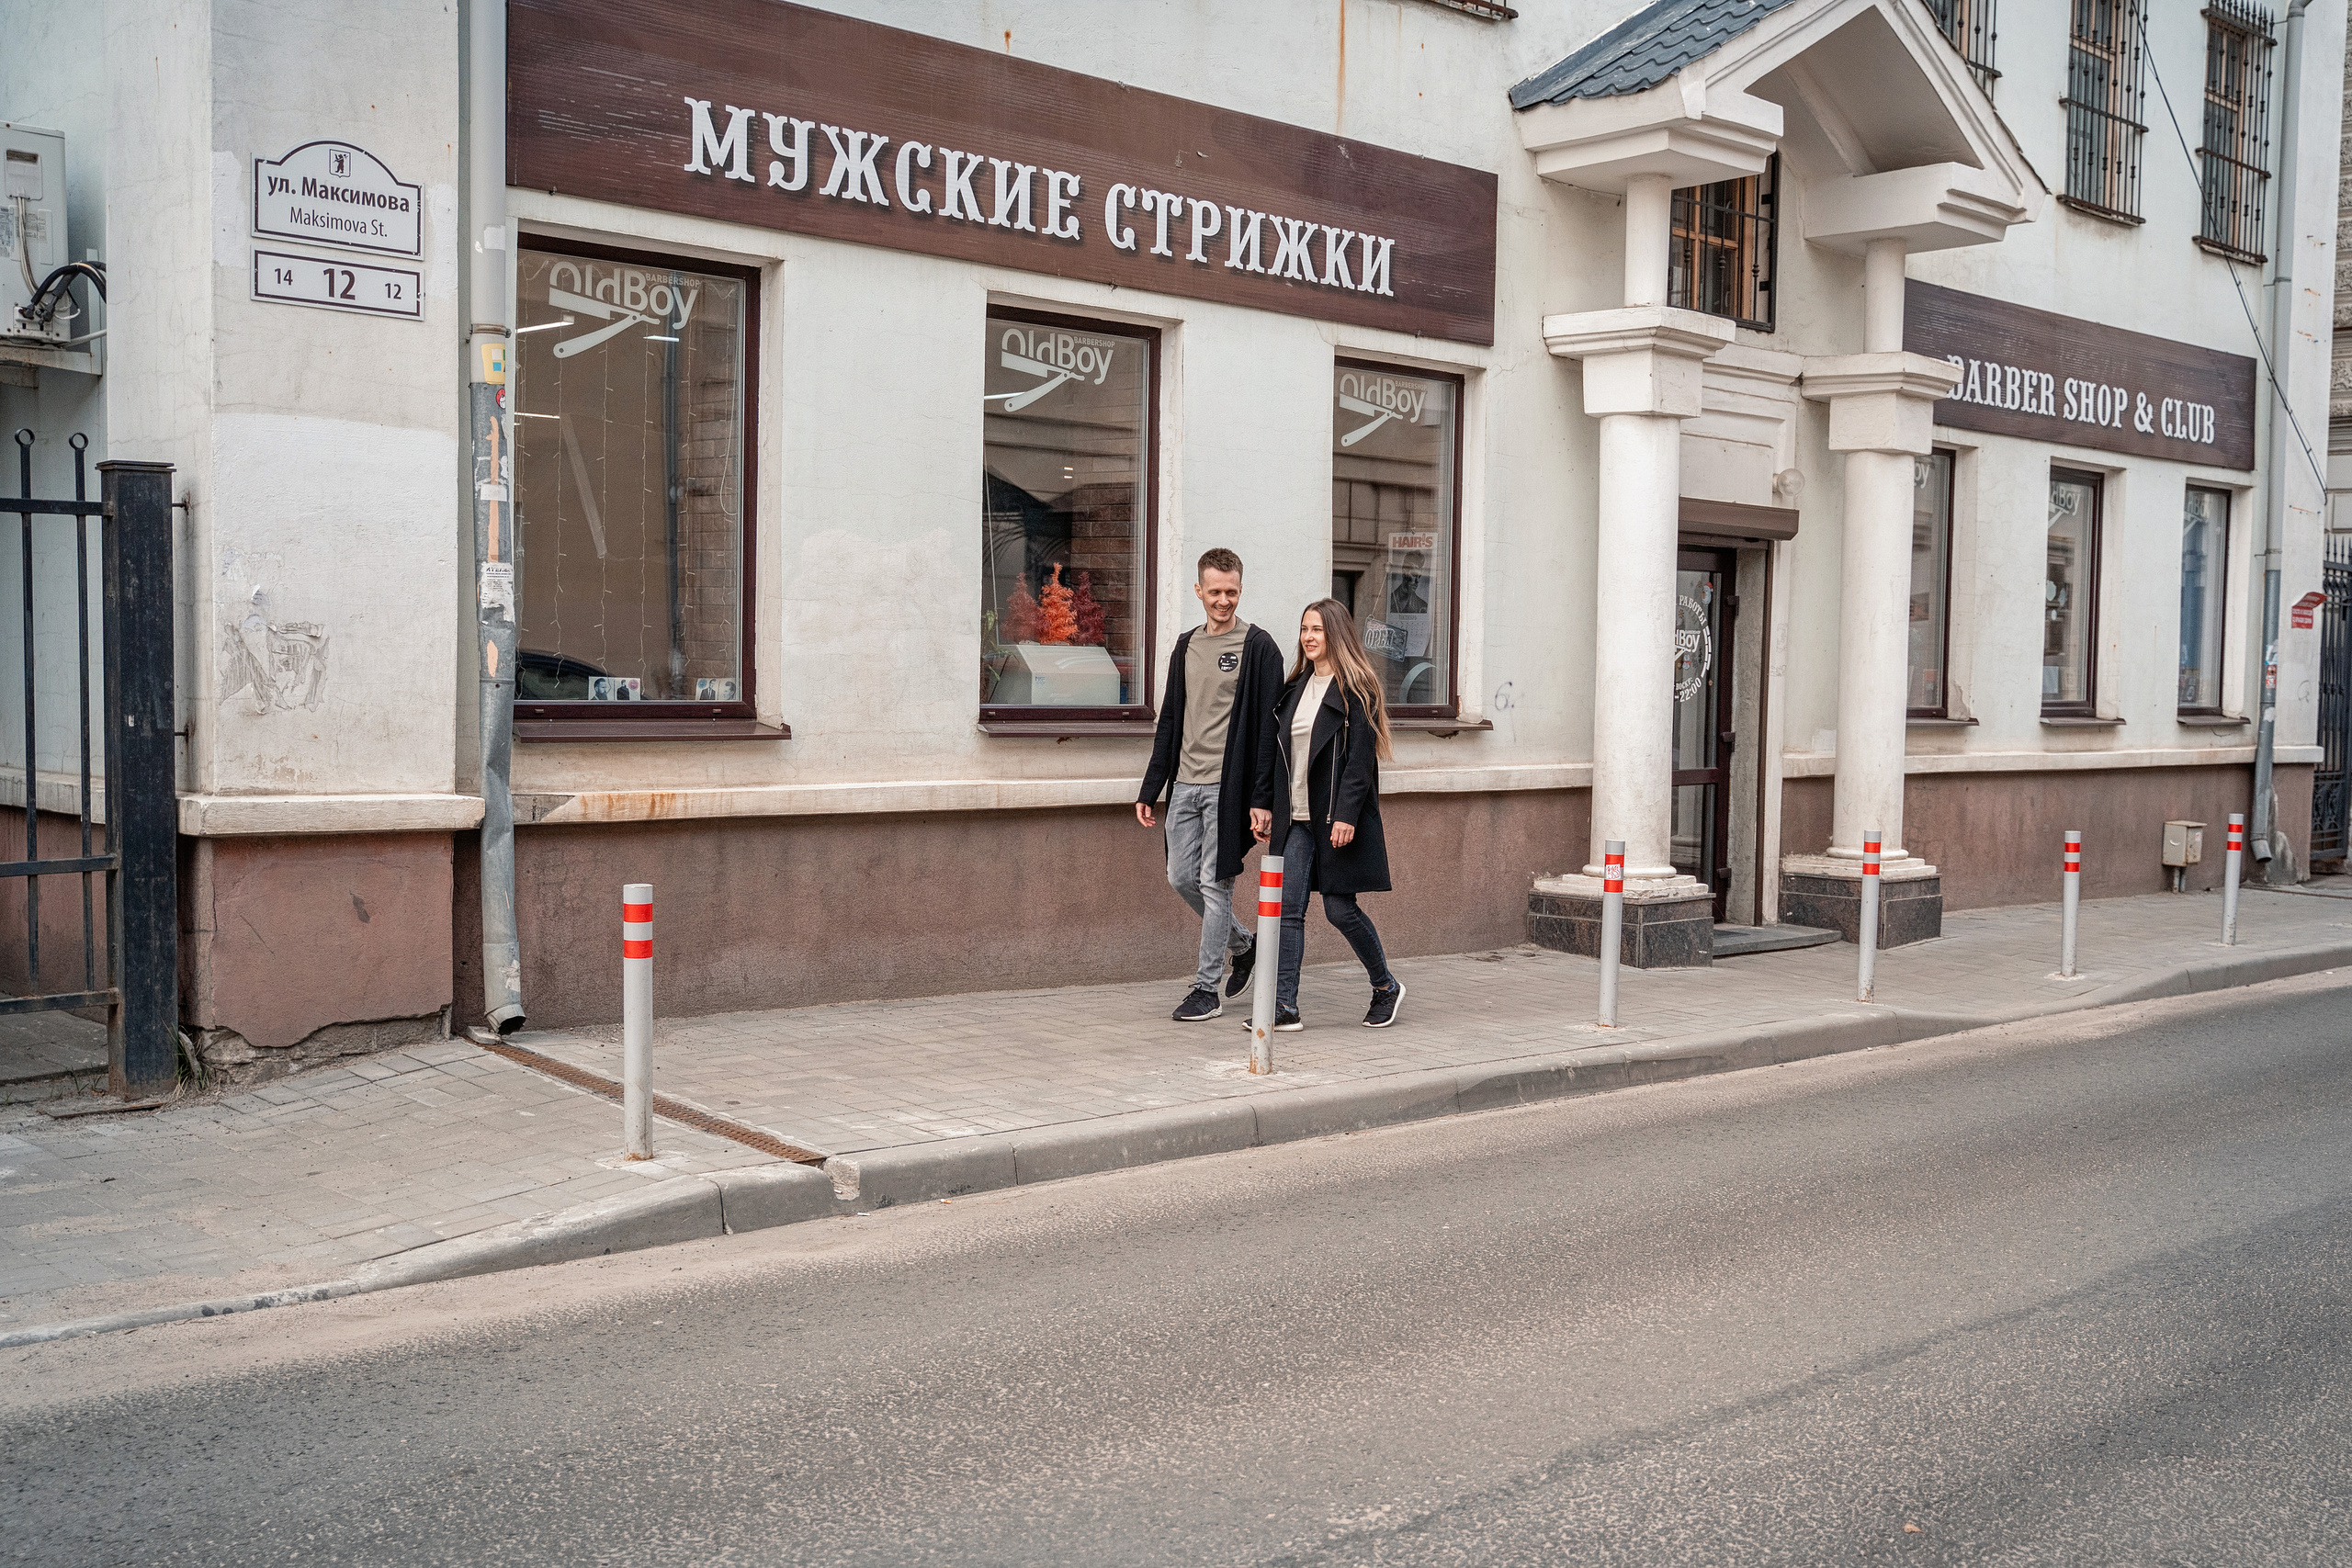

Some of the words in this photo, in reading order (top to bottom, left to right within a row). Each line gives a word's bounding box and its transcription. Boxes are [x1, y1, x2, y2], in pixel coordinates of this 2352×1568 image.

[267, 175, 296, 197] ул.
[301, 176, 410, 213] Максимова
[684, 96, 1081, 241] МУЖСКИЕ
[1104, 183, 1396, 297] СТРИЖКИ
[289, 207, 367, 234] Maksimova
[370, 219, 388, 238] St.
[274, 267, 293, 286] 14
[322, 267, 356, 300] 12
[384, 282, 402, 300] 12
[549, 261, 699, 330] OldBoy
[646, 273, 701, 288] BARBERSHOP
[1001, 328, 1114, 385] OldBoy
[1073, 336, 1115, 348] BARBERSHOP
[1340, 373, 1426, 423] OldBoy
[2063, 377, 2129, 428] SHOP
[2133, 391, 2155, 434] &
[2160, 397, 2215, 445] CLUB
[2051, 485, 2081, 516] dBoy
[1679, 594, 1708, 626] РАБОТЫ
[1364, 627, 1395, 649] OPEN
